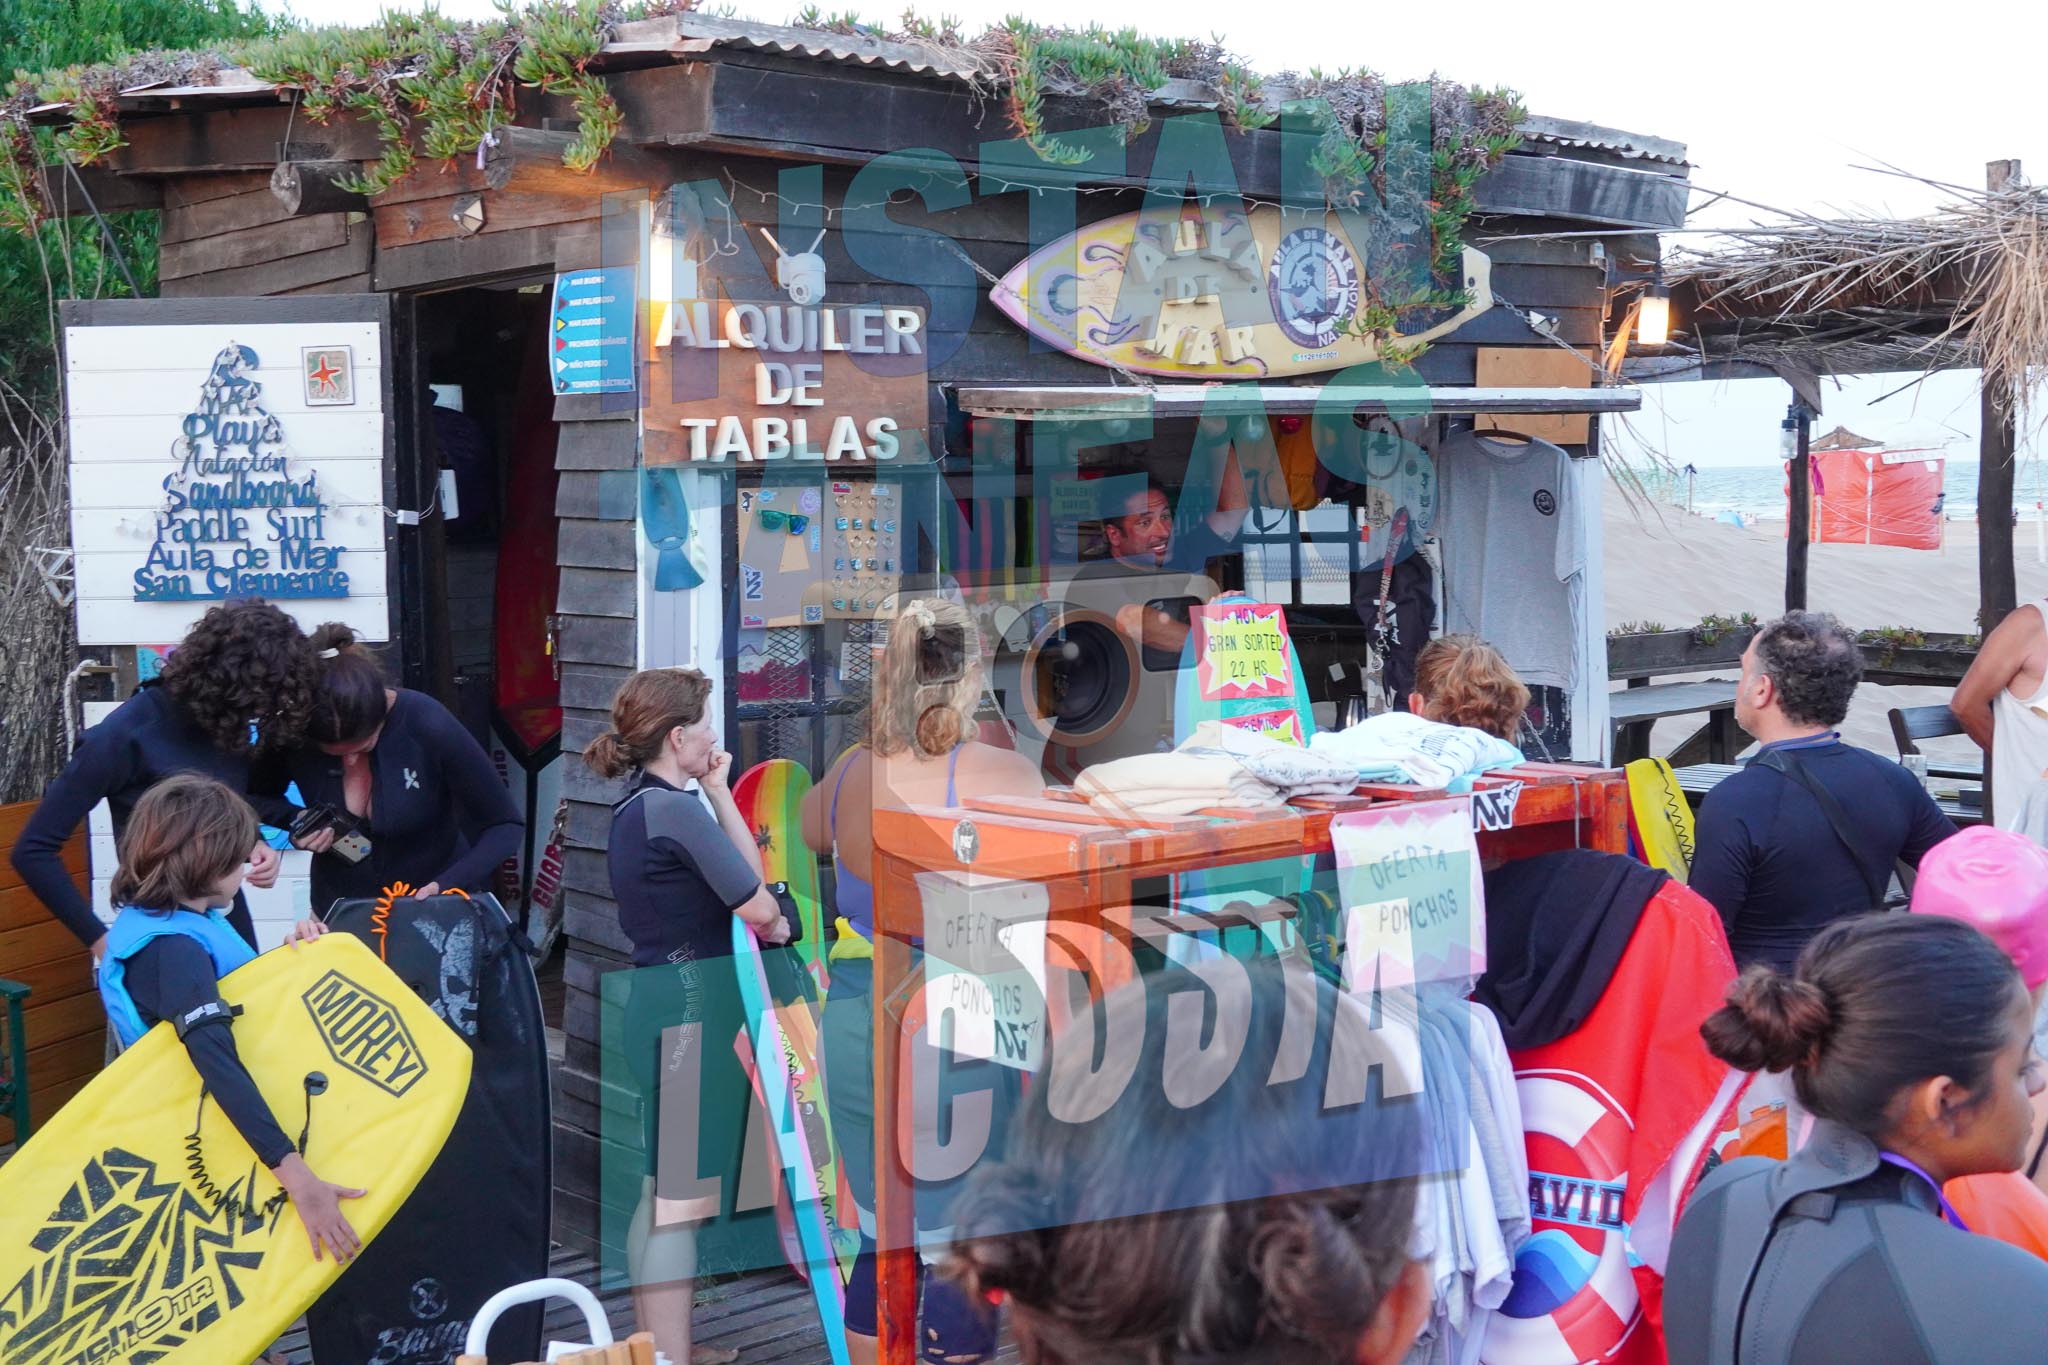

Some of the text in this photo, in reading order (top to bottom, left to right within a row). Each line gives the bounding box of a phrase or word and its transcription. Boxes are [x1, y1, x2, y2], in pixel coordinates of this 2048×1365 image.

[1133, 220, 1263, 282] AULA
[1271, 230, 1354, 278] AULA DE MAR
[1168, 276, 1221, 304] DE
[655, 302, 923, 354] ALQUILER
[1144, 324, 1258, 365] MAR
[755, 362, 825, 406] DE
[183, 413, 282, 456] Playa
[680, 416, 900, 463] TABLAS
[163, 469, 321, 512] Sandboard
[156, 503, 328, 544] Paddle Surf
[145, 538, 348, 570] Aula de Mar
[134, 565, 350, 596] San Clemente
[1235, 608, 1256, 625] HOY
[1208, 633, 1237, 653] GRAN
[1230, 660, 1246, 678] 22
[1369, 845, 1448, 891] OFERTA
[945, 912, 1014, 949] OFERTA
[1379, 888, 1458, 935] PONCHOS
[951, 974, 1023, 1017] PONCHOS
[312, 979, 419, 1084] MOREY
